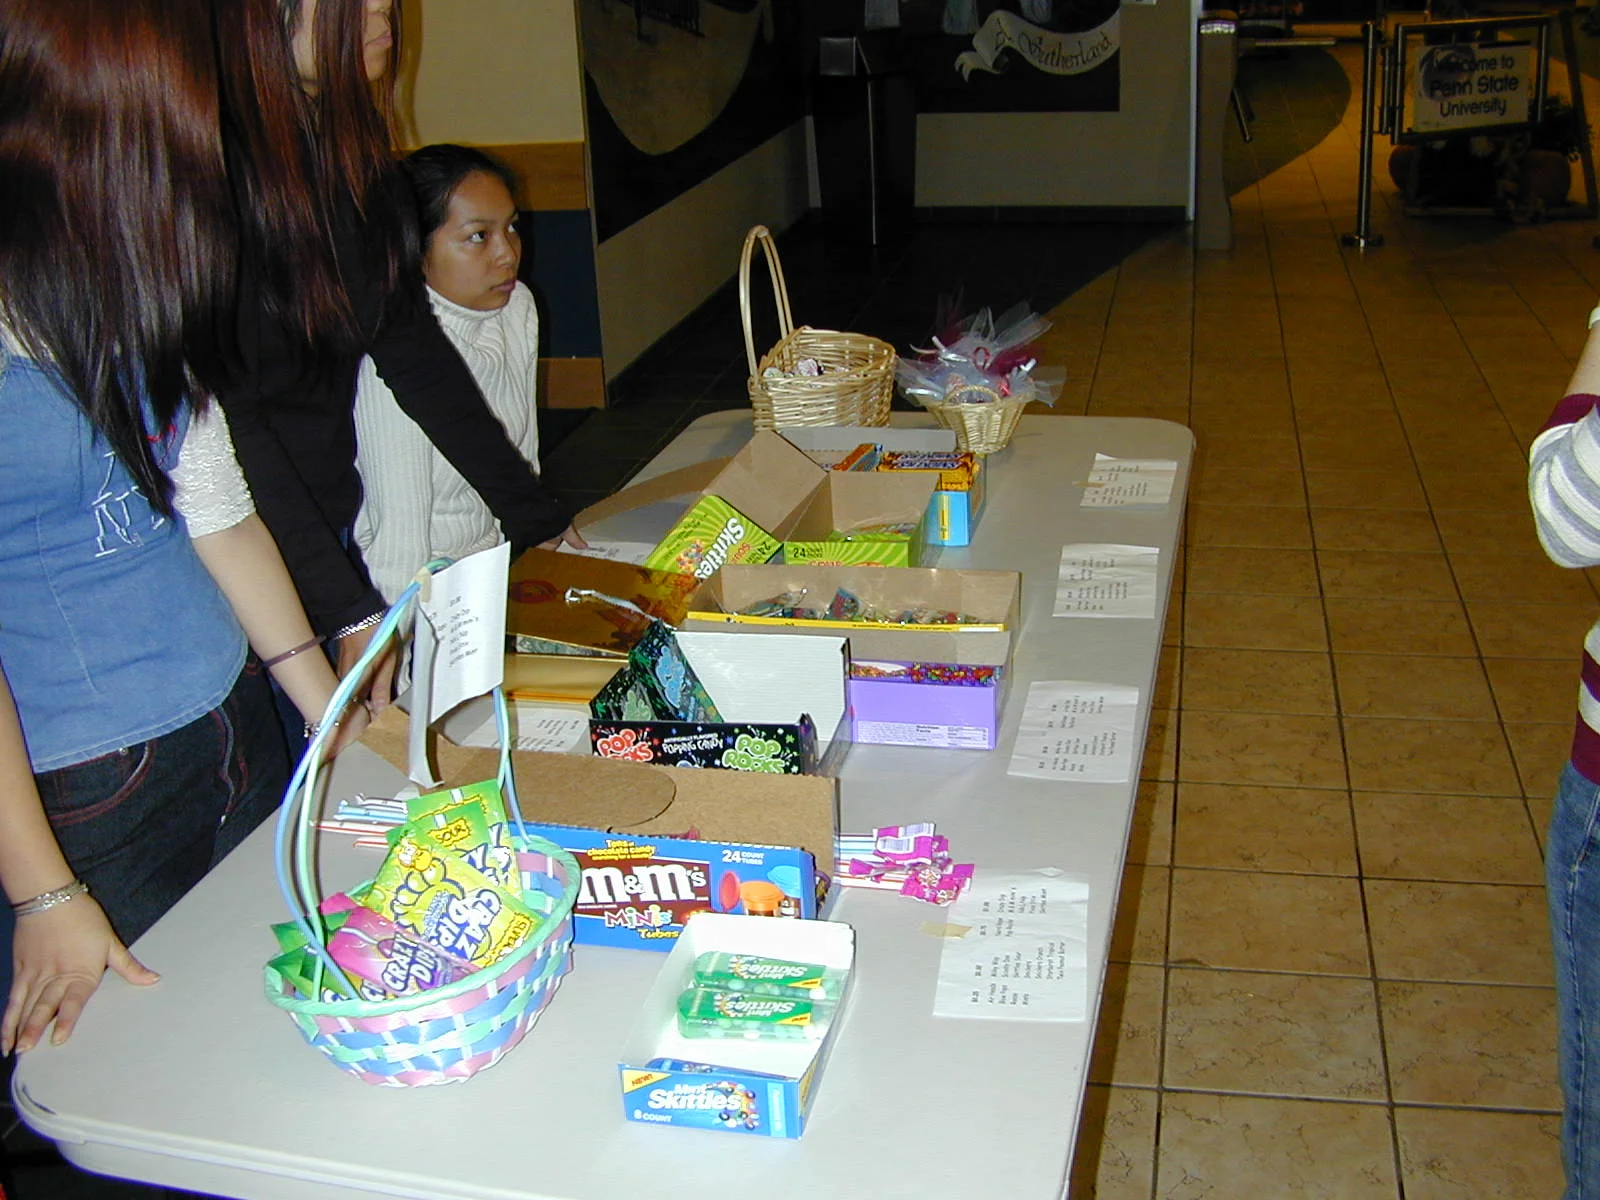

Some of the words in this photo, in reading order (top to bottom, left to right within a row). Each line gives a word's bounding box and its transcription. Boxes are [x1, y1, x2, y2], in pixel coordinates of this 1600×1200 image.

[1018, 31, 1113, 70] Sutherland
[1432, 56, 1497, 74] Wcome
[1502, 55, 1514, 69] to
[1430, 78, 1473, 98] Penn
[1478, 75, 1519, 94] State
[1440, 99, 1507, 117] University
[694, 517, 745, 579] Skittles
[793, 547, 806, 558] 24
[597, 729, 637, 757] POP
[662, 738, 697, 755] POPPING
[698, 737, 724, 751] CANDY
[735, 734, 781, 758] POP
[434, 824, 465, 844] SOUR
[629, 846, 656, 856] candy
[722, 849, 742, 864] 24
[741, 851, 765, 859] COUNT
[459, 888, 503, 960] CRAZ
[638, 929, 680, 940] Tubes
[738, 962, 808, 978] Skittles
[725, 1000, 796, 1014] Skittles
[648, 1088, 741, 1110] Skittles
[643, 1112, 673, 1123] COUNT
